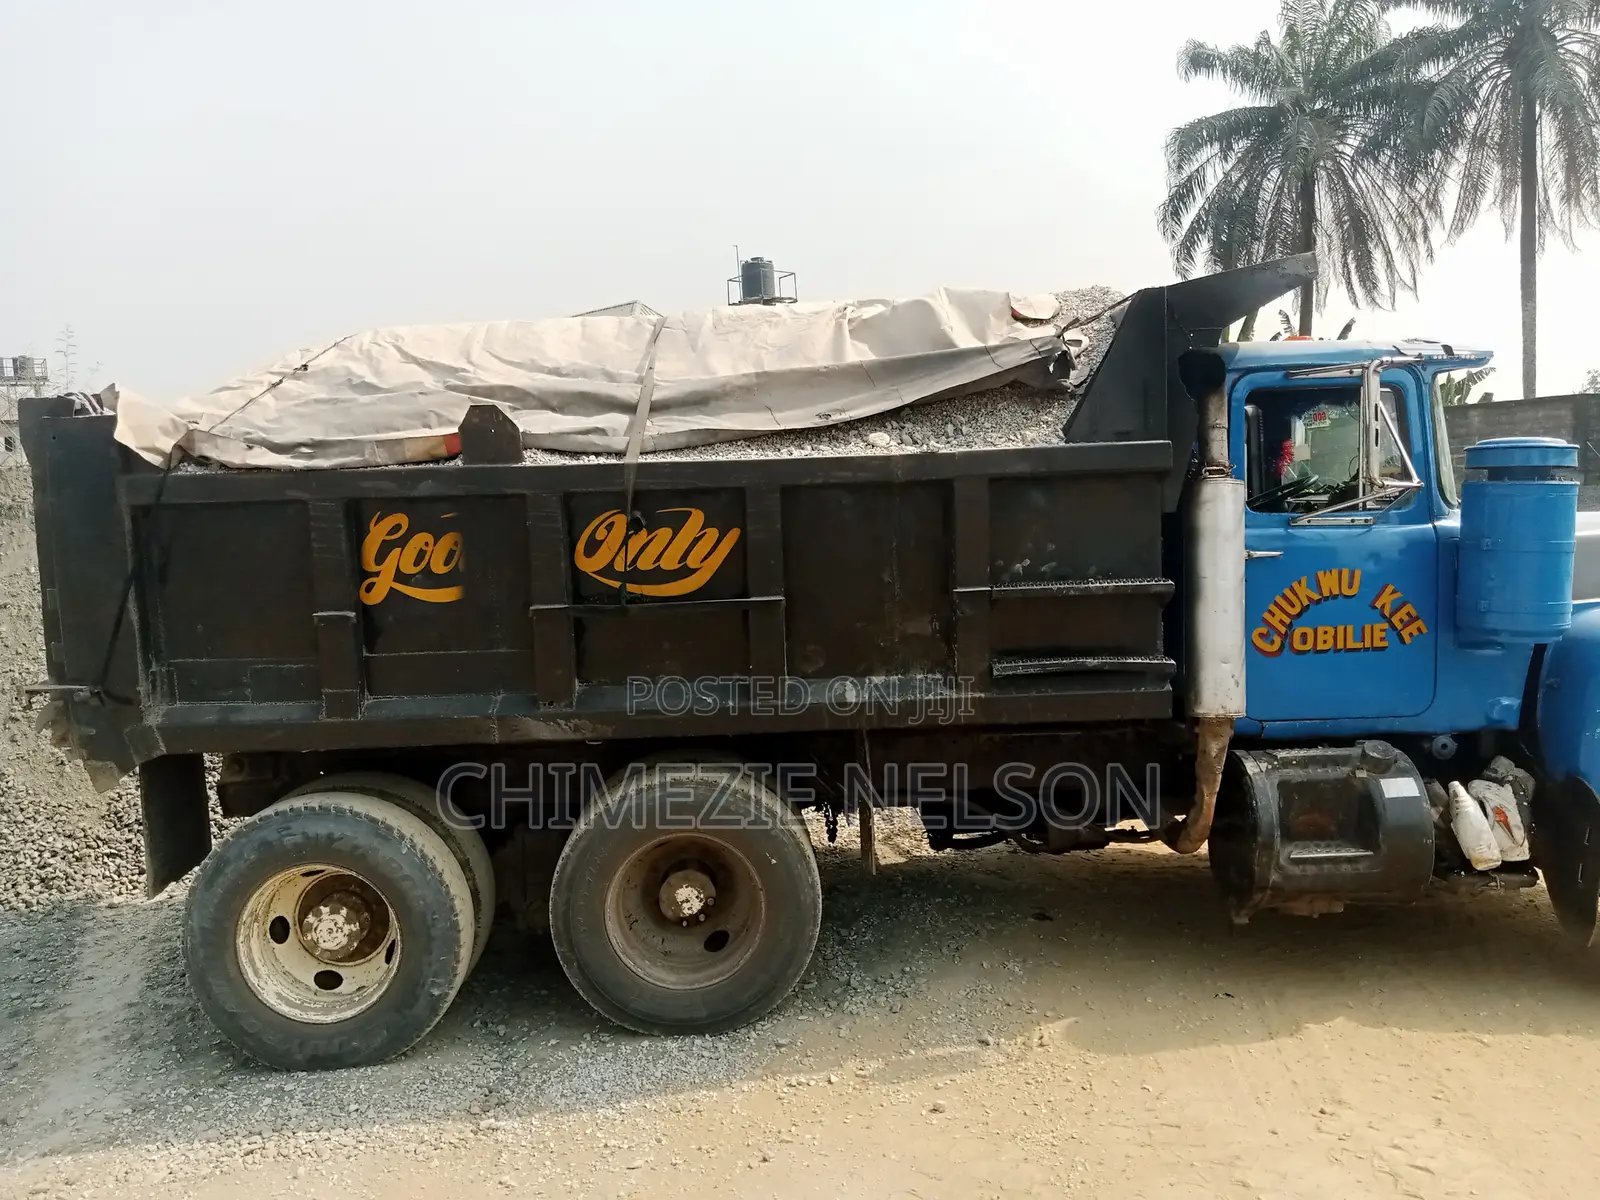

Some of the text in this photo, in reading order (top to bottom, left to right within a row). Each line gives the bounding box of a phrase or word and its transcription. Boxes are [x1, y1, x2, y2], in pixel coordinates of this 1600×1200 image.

[574, 507, 742, 597] Only
[1251, 568, 1429, 658] CHUKWU KEE
[1289, 622, 1390, 655] OBILIE
